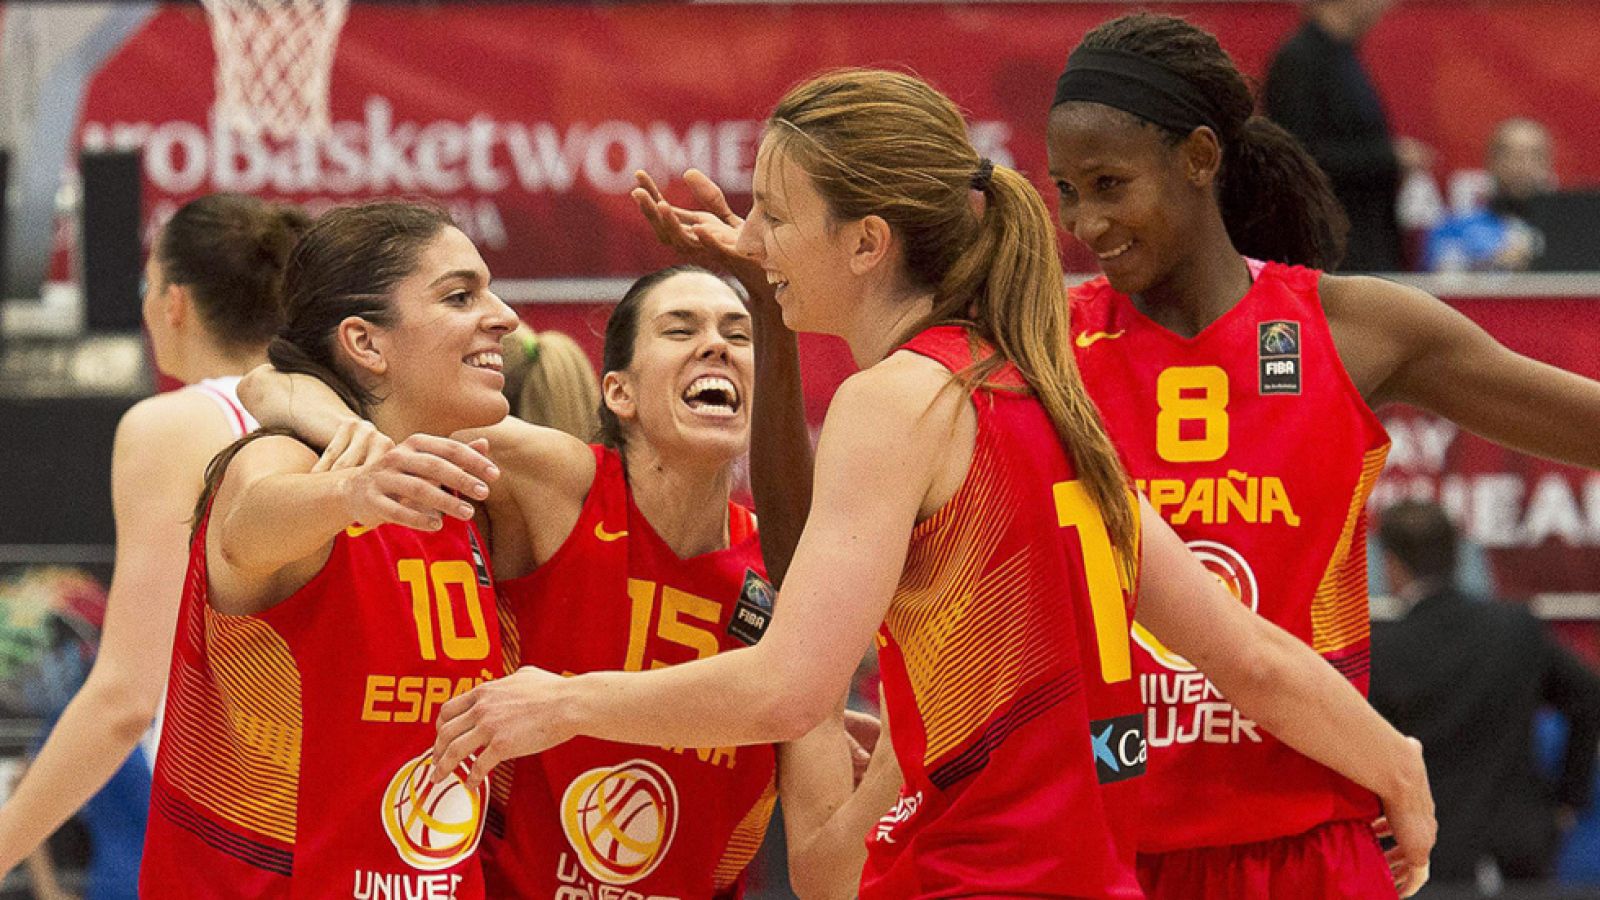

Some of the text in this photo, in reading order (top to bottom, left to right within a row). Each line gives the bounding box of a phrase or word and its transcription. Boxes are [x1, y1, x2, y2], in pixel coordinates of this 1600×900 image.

[1265, 360, 1294, 377] FIBA
[1156, 366, 1229, 463] 8
[1134, 469, 1300, 528] PAÑA
[397, 558, 491, 661] 10
[1052, 479, 1141, 685] 1
[624, 577, 722, 672] 15
[737, 607, 765, 630] FIBA
[361, 668, 494, 723] ESP
[1146, 703, 1263, 748] UJER
